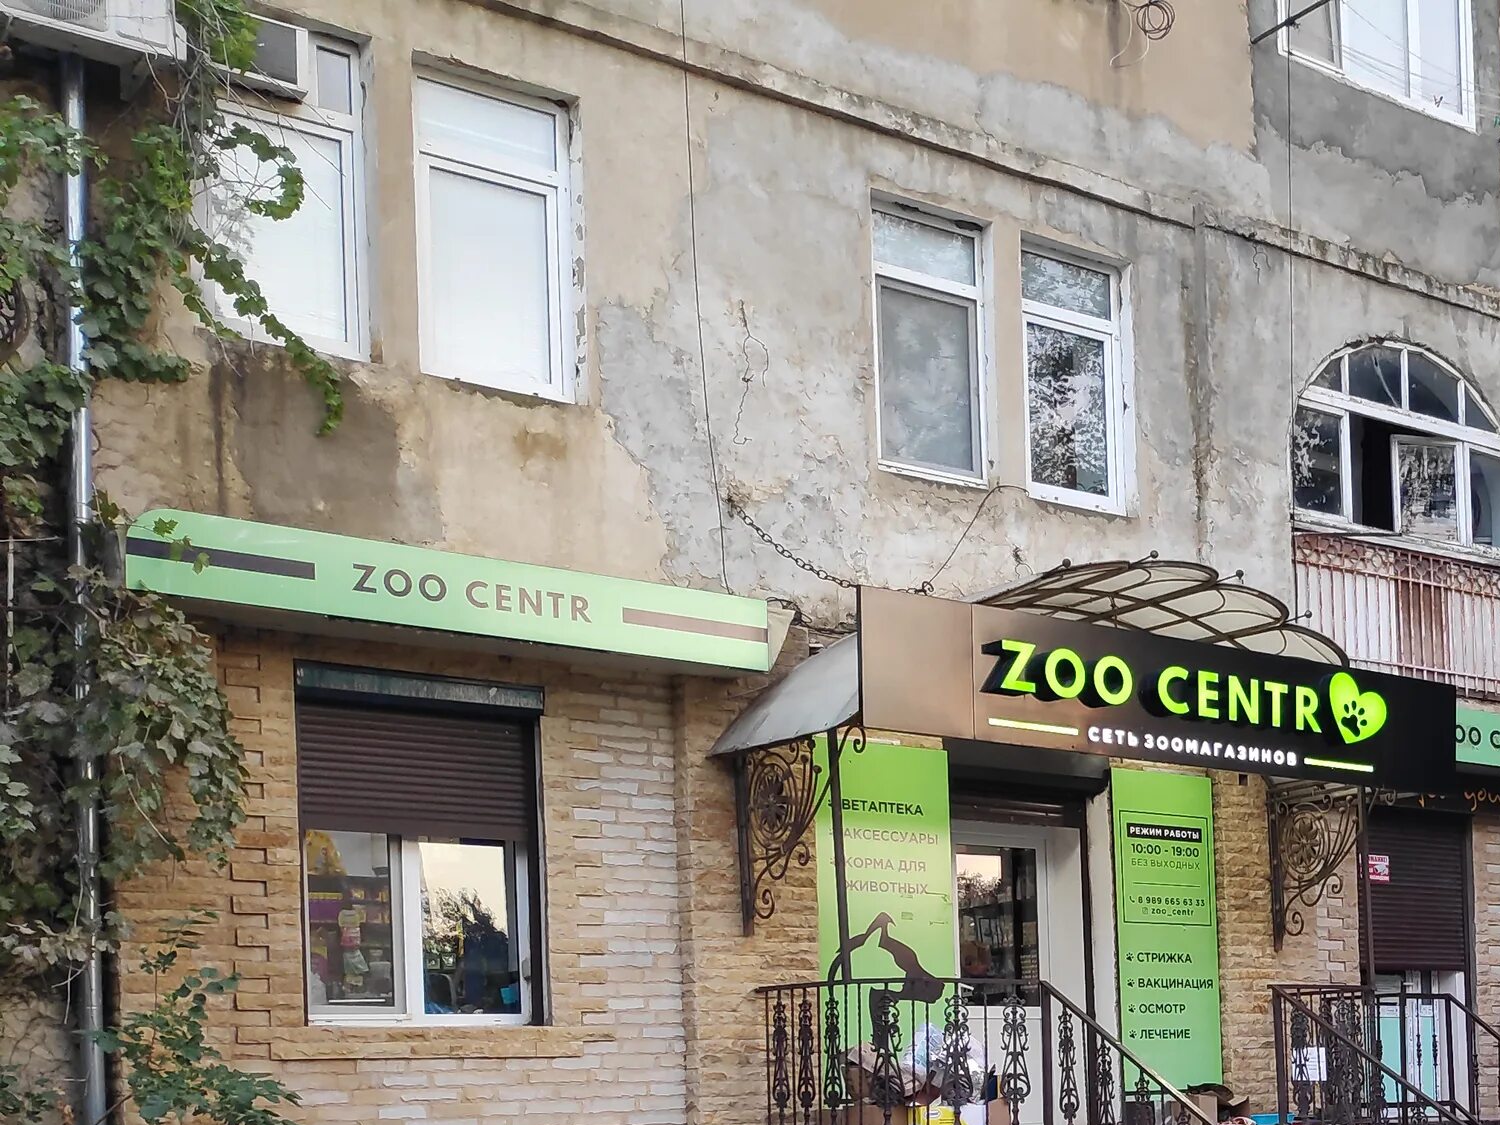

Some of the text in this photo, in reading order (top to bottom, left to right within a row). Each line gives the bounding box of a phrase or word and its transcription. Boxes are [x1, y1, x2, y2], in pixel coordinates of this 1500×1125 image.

[352, 563, 592, 624] ZOO CENTR
[1001, 639, 1322, 734] ZOO CENTR
[1455, 724, 1482, 746] OO
[1087, 726, 1298, 767] СЕТЬ ЗООМАГАЗИНОВ
[841, 798, 924, 817] ВЕТАПТЕКА
[843, 827, 938, 846] АКСЕССУАРЫ
[1129, 826, 1199, 839] РЕЖИМ РАБОТЫ
[1131, 843, 1161, 855] 10:00
[1171, 846, 1199, 858] 19:00
[898, 860, 926, 873] ДЛЯ
[1131, 858, 1200, 870] БЕЗ ВЫХОДНЫХ
[845, 880, 928, 895] ЖИВОТНЫХ
[1138, 896, 1205, 907] 8 989 665 63 33
[1151, 907, 1194, 917] zoo_centr
[1136, 952, 1193, 963] СТРИЖКА
[1137, 978, 1214, 990] ВАКЦИНАЦИЯ
[1138, 1003, 1186, 1014] ОСМОТР
[1139, 1028, 1191, 1039] ЛЕЧЕНИЕ
